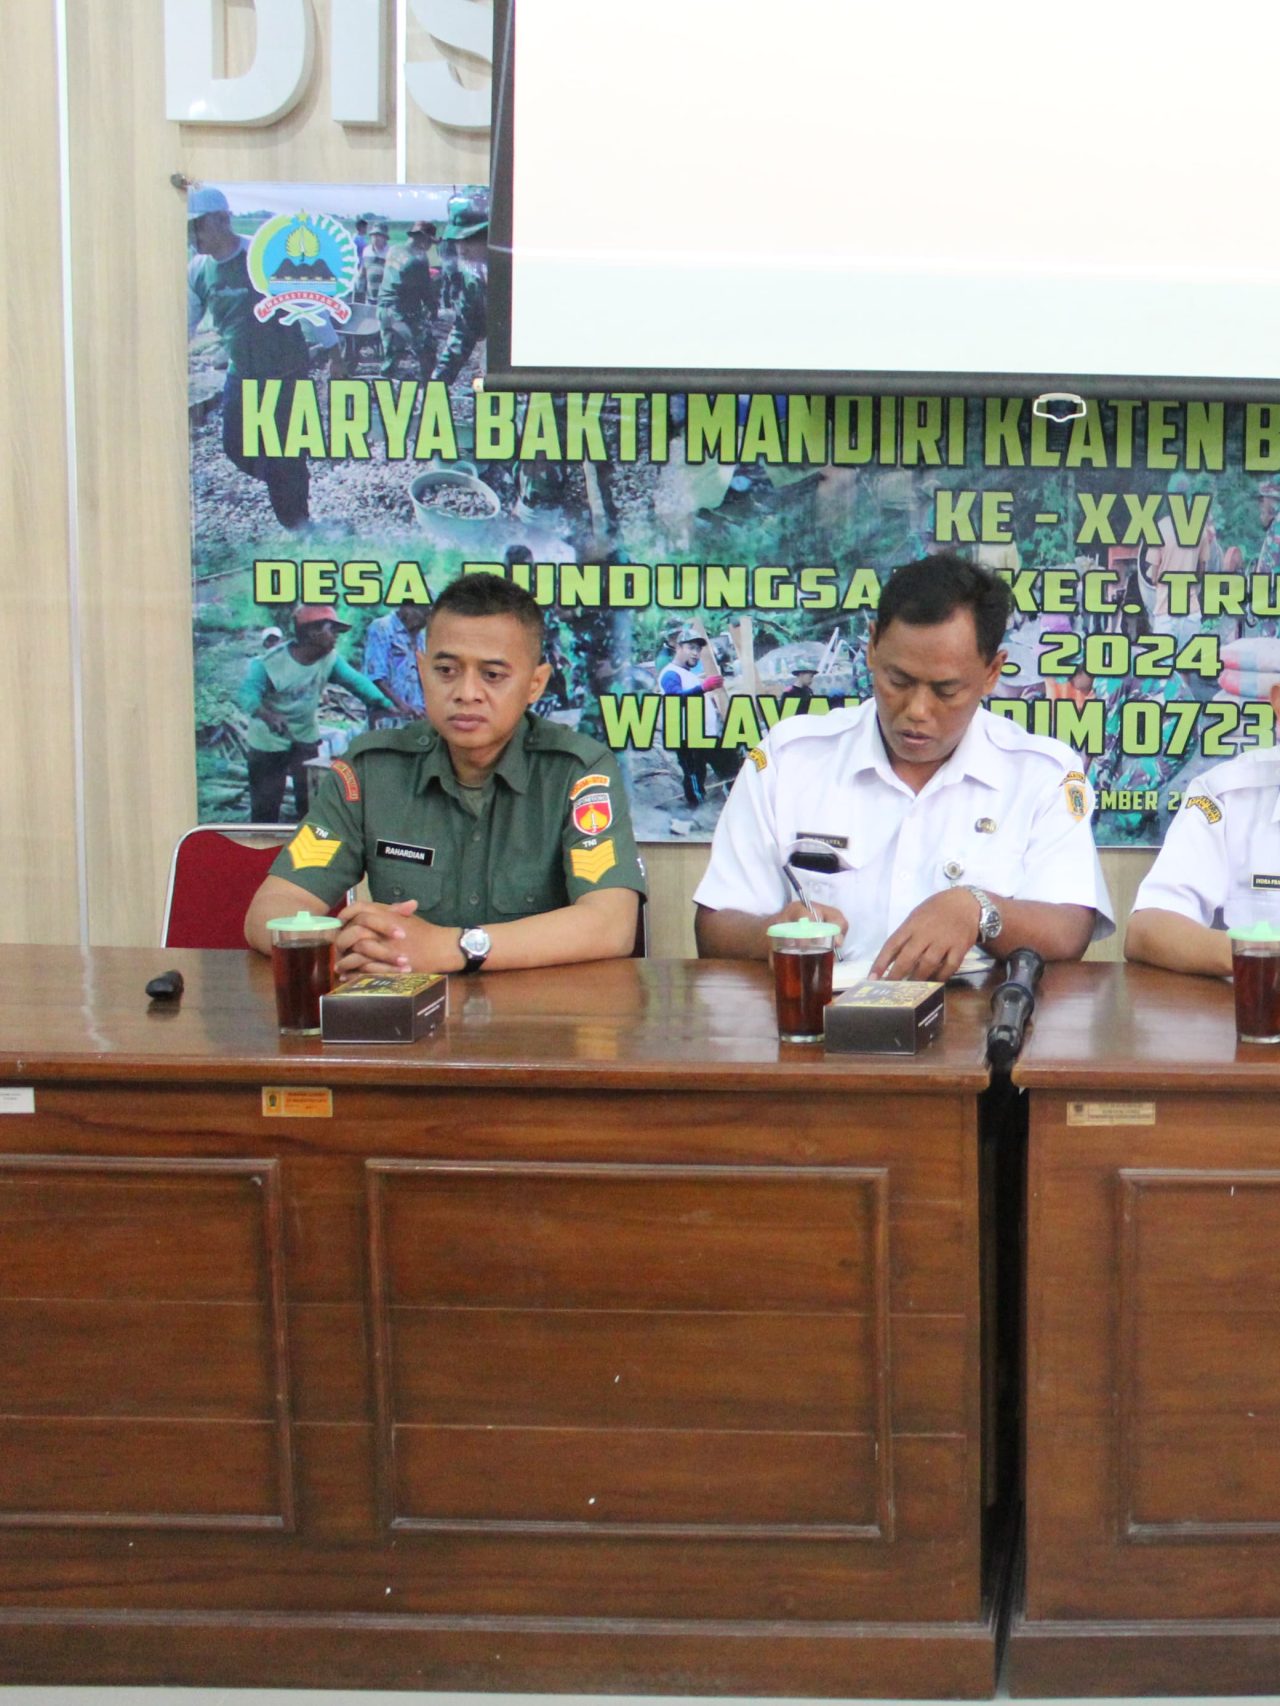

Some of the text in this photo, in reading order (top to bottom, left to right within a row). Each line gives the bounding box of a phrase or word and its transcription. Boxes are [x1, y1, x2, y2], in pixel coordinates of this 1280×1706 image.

[164, 0, 493, 128] DIS
[241, 378, 458, 460] KARYA
[474, 391, 670, 463] BAKTI
[686, 393, 966, 468] MANDIRI
[983, 397, 1224, 472] KLATEN
[935, 490, 1015, 543] KE
[1076, 492, 1210, 547] XXV
[253, 560, 432, 607] DESA
[993, 568, 1142, 617] KEC.
[1038, 632, 1224, 678] 2024
[384, 846, 426, 860] RAHARDIAN
